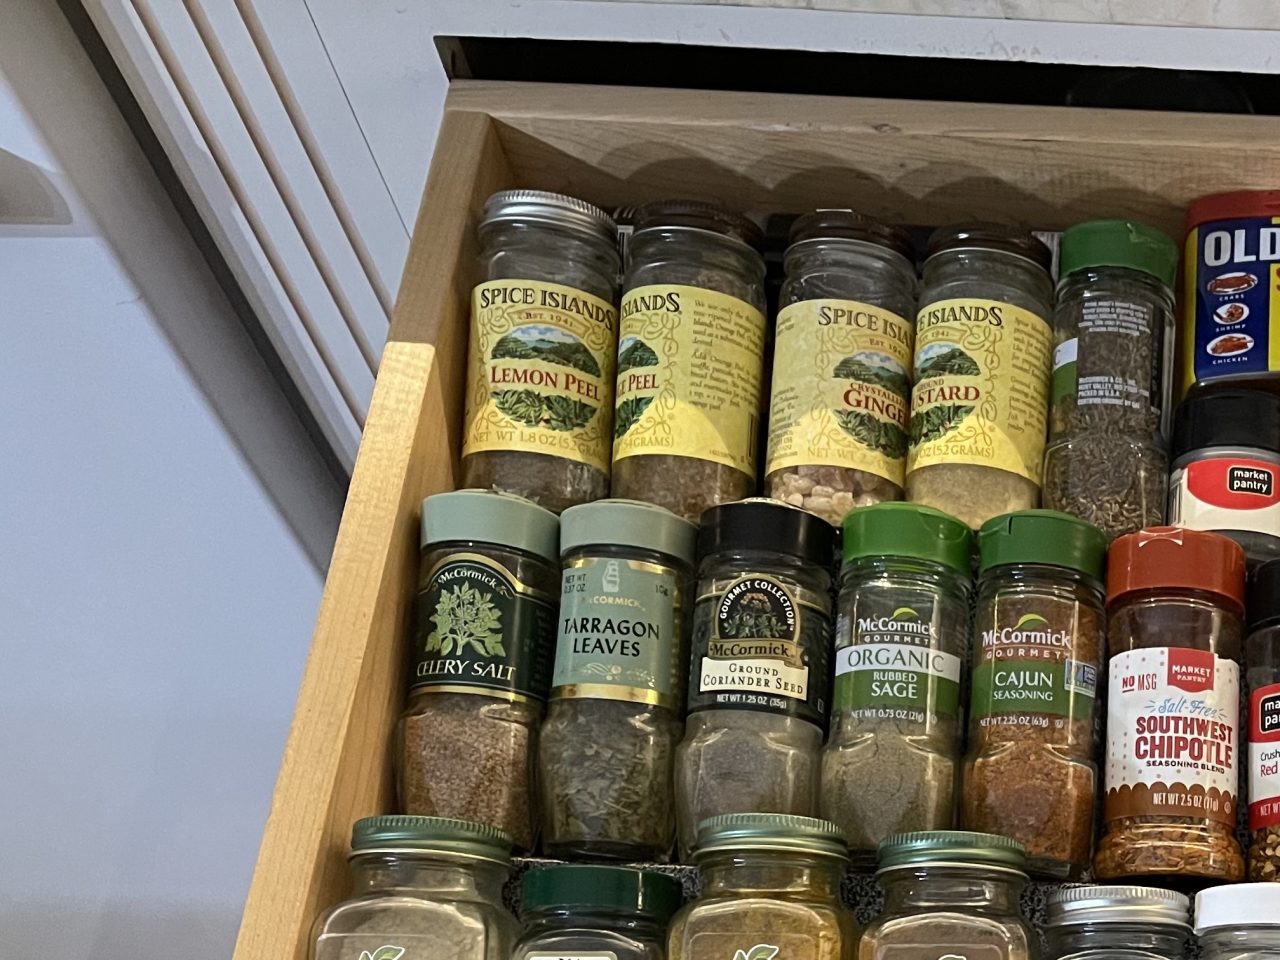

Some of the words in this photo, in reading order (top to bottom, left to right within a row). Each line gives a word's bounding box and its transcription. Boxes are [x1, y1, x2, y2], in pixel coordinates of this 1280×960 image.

[480, 287, 535, 308] SPICE
[541, 290, 614, 331] ISLANDS
[819, 306, 878, 331] SPICE
[928, 306, 1003, 327] ISLANDS
[490, 366, 557, 388] LEMON
[564, 373, 600, 401] PEEL
[629, 374, 659, 391] PEEL
[1234, 469, 1269, 481] market
[1233, 479, 1268, 493] pantry
[438, 569, 497, 588] McCormick
[720, 581, 751, 619] GOURMET
[564, 618, 660, 640] TARRAGON
[857, 617, 938, 639] McCormick
[573, 638, 640, 657] LEAVES
[982, 628, 1072, 650] McCormick
[711, 643, 790, 658] McCormick
[729, 663, 779, 677] GROUND
[848, 648, 945, 673] ORGANIC
[417, 659, 470, 677] CELERY
[471, 661, 516, 682] SALT
[873, 671, 917, 683] RUBBED
[995, 671, 1053, 688] CAJUN
[1172, 665, 1211, 677] MARKET
[703, 675, 771, 688] CORIANDER
[775, 677, 803, 694] SEED
[871, 682, 918, 699] SAGE
[1137, 673, 1157, 690] MSG
[993, 690, 1053, 701] SEASONING
[1158, 696, 1218, 717] Salt-Free
[1136, 716, 1233, 744] SOUTHWEST
[1135, 736, 1232, 769] CHIPOTLE
[1146, 760, 1199, 769] SEASONING
[1201, 763, 1225, 774] BLEND
[1261, 761, 1278, 777] Red
